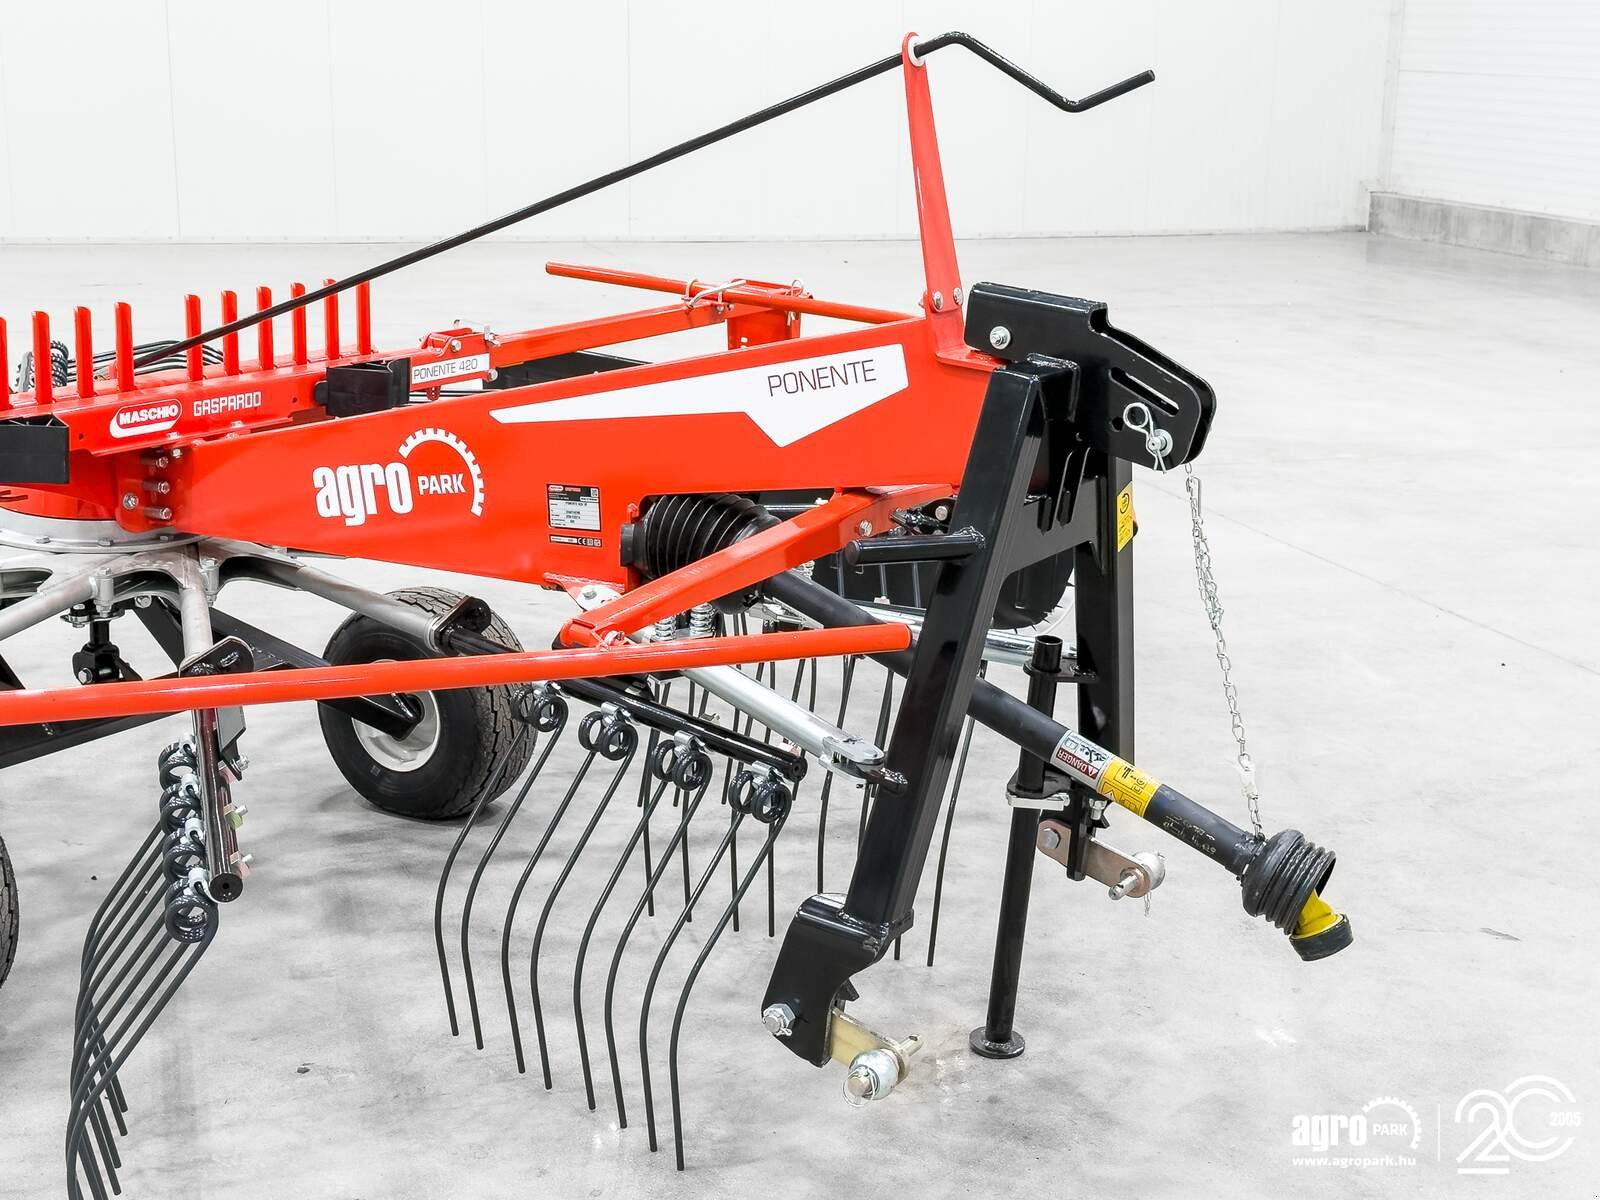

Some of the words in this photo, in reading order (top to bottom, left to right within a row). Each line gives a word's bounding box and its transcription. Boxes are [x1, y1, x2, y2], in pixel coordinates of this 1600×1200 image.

[413, 362, 456, 380] PONENTE
[458, 358, 478, 372] 420
[767, 359, 877, 397] PONENTE
[119, 404, 179, 425] MASCHIO
[193, 391, 262, 417] GASPARDO
[312, 462, 414, 527] agro
[416, 473, 466, 496] PARK
[1056, 748, 1088, 772] DANGER
